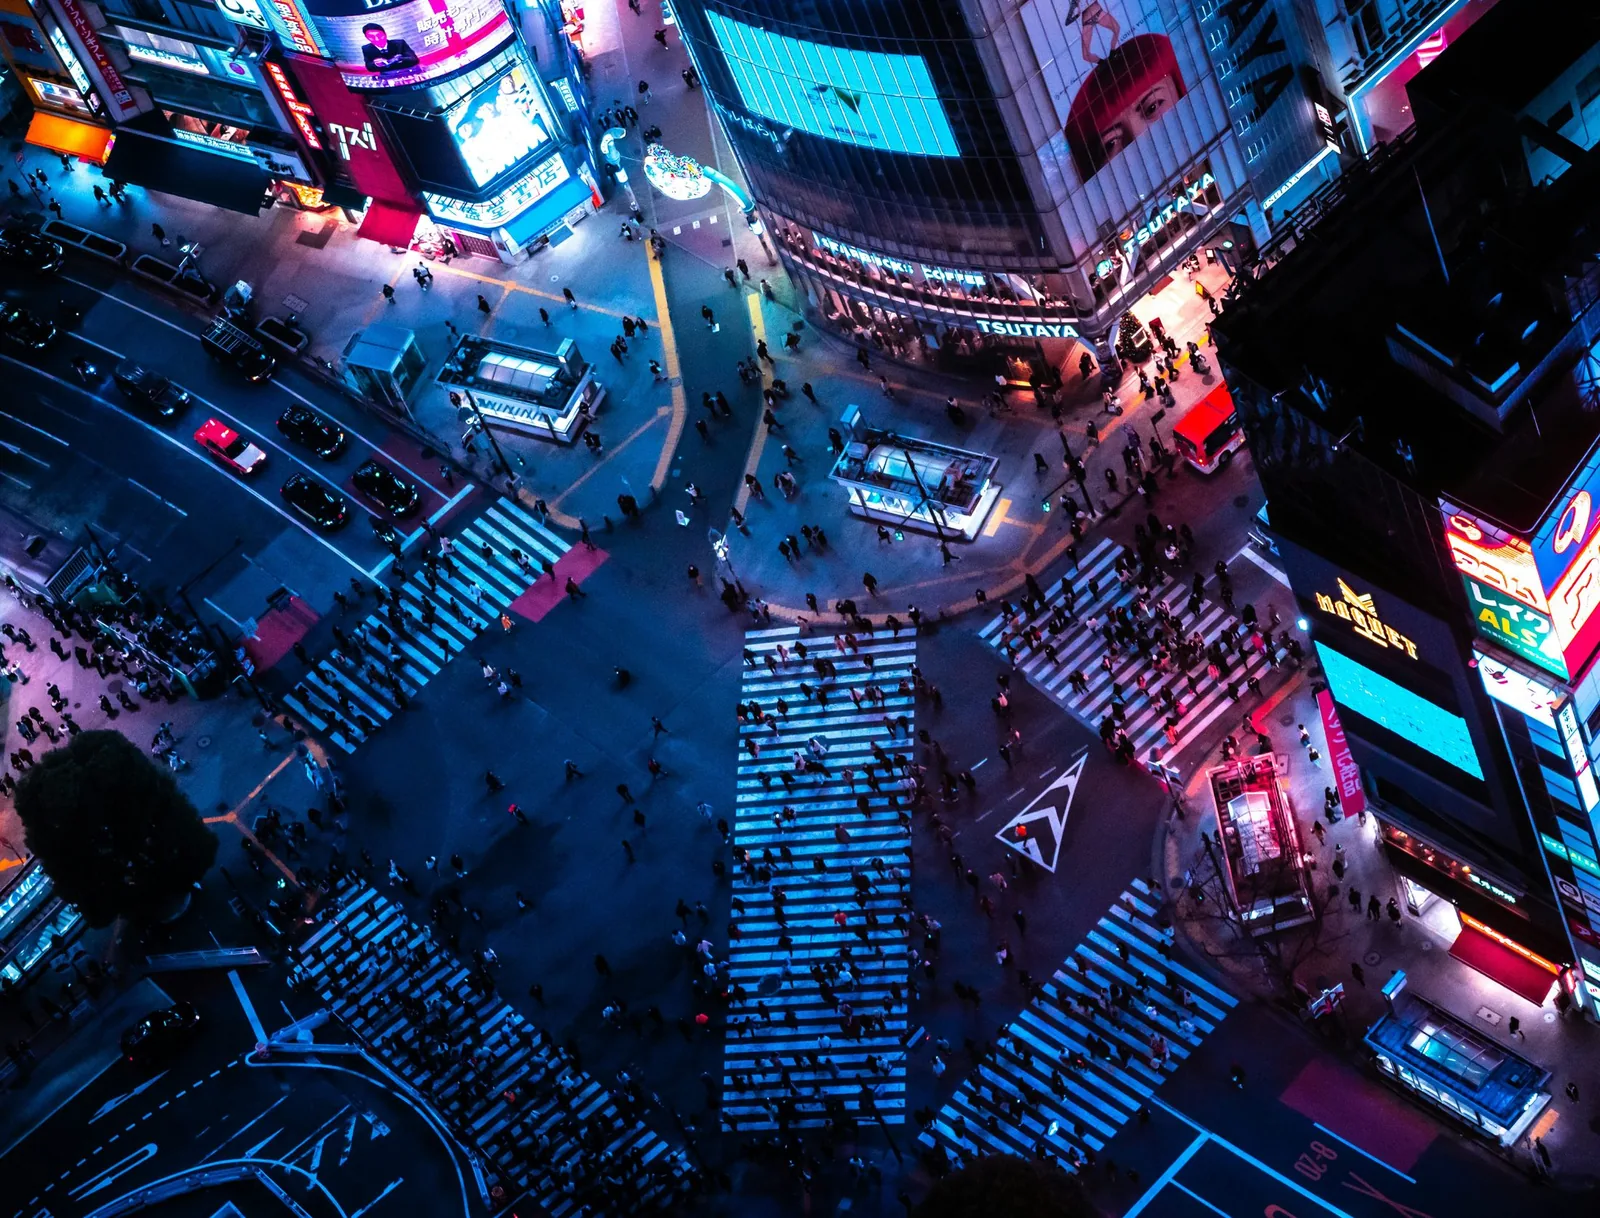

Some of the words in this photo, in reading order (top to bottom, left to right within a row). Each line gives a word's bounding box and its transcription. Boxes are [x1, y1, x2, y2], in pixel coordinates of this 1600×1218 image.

[1122, 172, 1216, 255] TSUTAYA
[820, 236, 914, 276] STARBUCKS
[921, 264, 987, 287] COFFEE
[976, 319, 1080, 338] TSUTAYA
[1470, 581, 1551, 634] レイク
[1478, 607, 1540, 649] ALS
